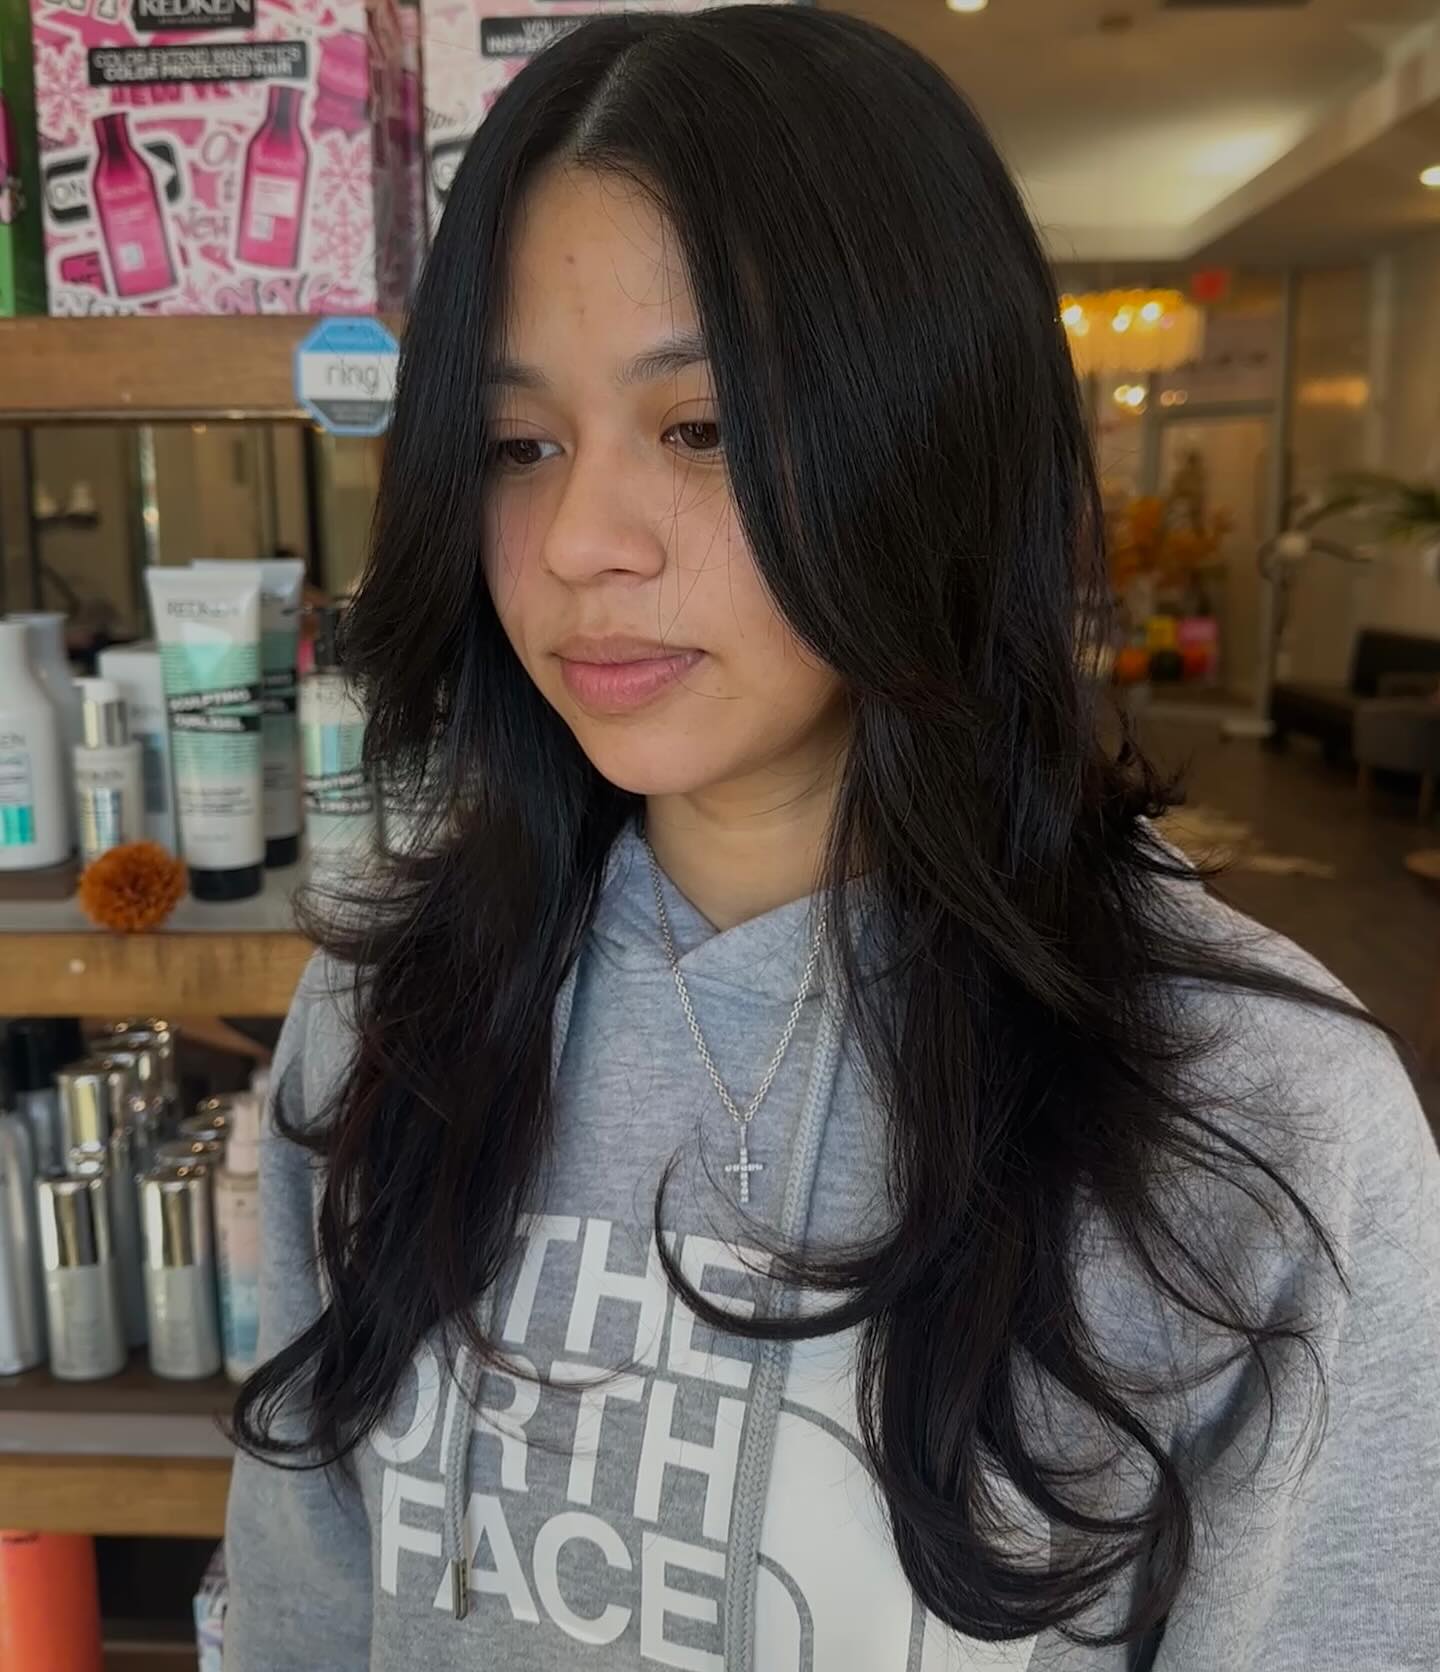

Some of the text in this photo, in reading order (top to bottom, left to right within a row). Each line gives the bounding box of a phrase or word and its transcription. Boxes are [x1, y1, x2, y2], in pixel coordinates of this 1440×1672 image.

[327, 358, 379, 395] ring
[502, 1213, 773, 1390] THE
[366, 1339, 746, 1543] ORTH
[380, 1467, 727, 1672] FACE
